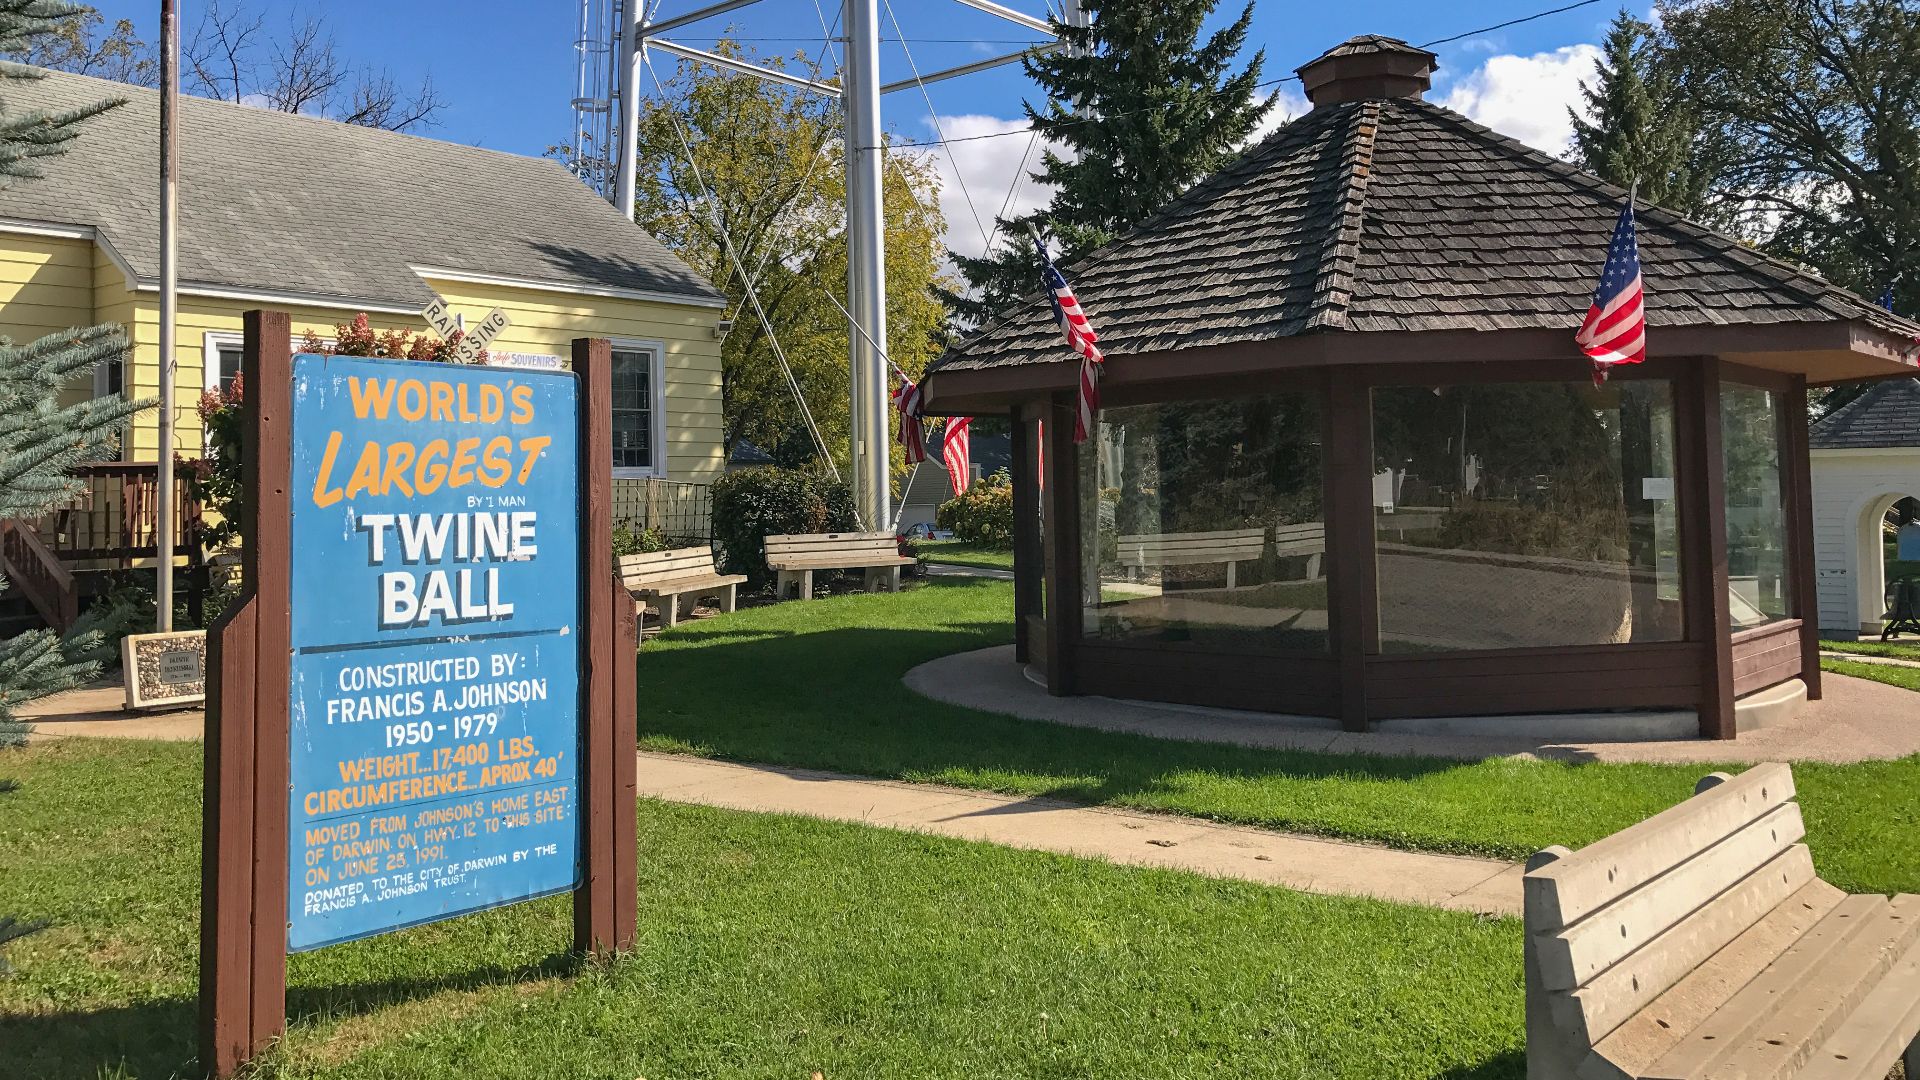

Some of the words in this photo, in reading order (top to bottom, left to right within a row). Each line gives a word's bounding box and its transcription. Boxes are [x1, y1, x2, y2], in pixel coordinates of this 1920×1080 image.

[511, 353, 557, 368] SOUVENIRS
[348, 376, 535, 424] WORLD'S
[313, 431, 551, 508] LARGEST
[467, 495, 483, 508] BY
[498, 495, 526, 508] MAN
[357, 511, 538, 565] TWINE
[379, 567, 514, 630] BALL
[340, 656, 480, 692] CONSTRUCTED
[491, 652, 526, 677] BY:
[327, 691, 425, 725] FRANCIS
[386, 720, 434, 748] 1950
[454, 712, 498, 740] 1979
[498, 736, 540, 762] LBS.
[305, 848, 325, 866] OF
[398, 832, 417, 850] ON
[464, 821, 477, 838] 12
[484, 817, 500, 834] TO
[505, 812, 531, 829] THIS
[306, 821, 361, 848] MOVED
[370, 814, 407, 836] FROM
[414, 800, 485, 828] JOHNSON'S
[491, 793, 529, 815] HOME
[534, 786, 569, 807] EAST
[305, 865, 330, 887] ON
[338, 856, 379, 881] JUNE
[415, 845, 449, 865] 1991.
[305, 882, 364, 905] DONATED
[372, 877, 388, 891] TO
[393, 872, 414, 887] THE
[420, 865, 444, 881] CITY
[464, 854, 507, 872] DARWIN
[513, 849, 529, 862] BY
[534, 843, 557, 858] THE
[304, 896, 356, 917] FRANCIS
[361, 893, 373, 904] A.
[377, 881, 428, 901] JOHNSON
[434, 873, 467, 889] TRUST.
